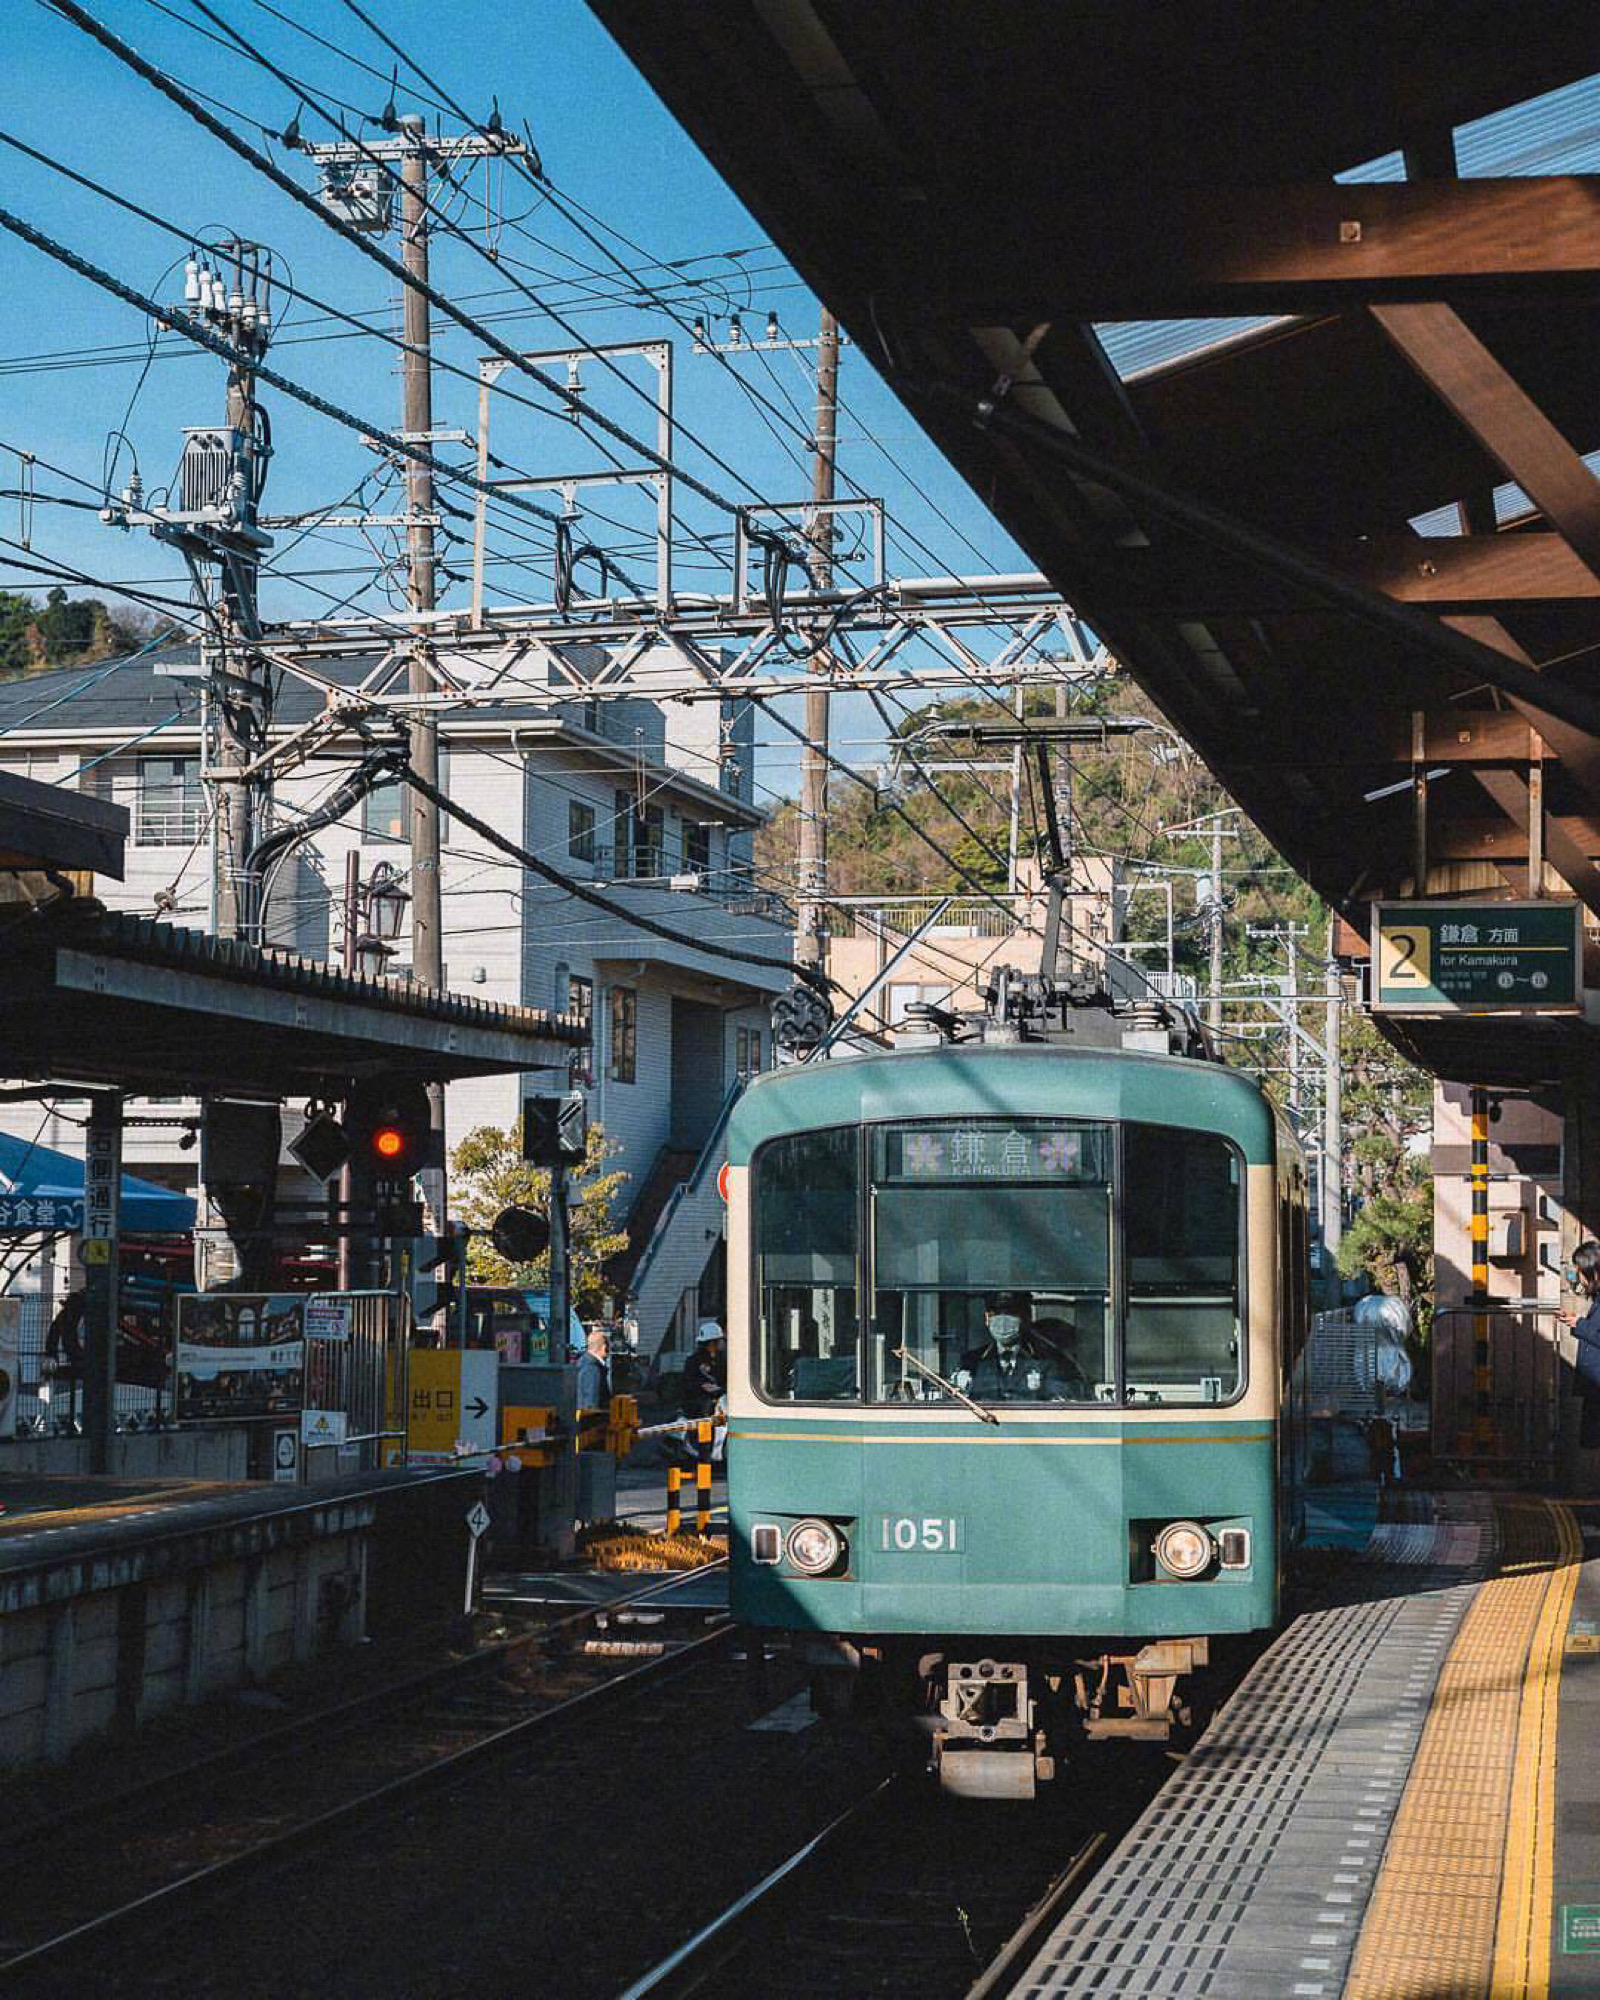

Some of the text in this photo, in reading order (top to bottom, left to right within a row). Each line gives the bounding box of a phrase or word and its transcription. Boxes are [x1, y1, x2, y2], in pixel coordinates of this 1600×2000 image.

[1440, 924, 1518, 943] 鎌倉 方面
[1389, 934, 1416, 978] 2
[1440, 954, 1518, 967] for Kamakura
[951, 1130, 1032, 1164] 鎌倉
[413, 1388, 453, 1409] 出口
[471, 1507, 485, 1529] 4
[882, 1518, 956, 1551] 1051
